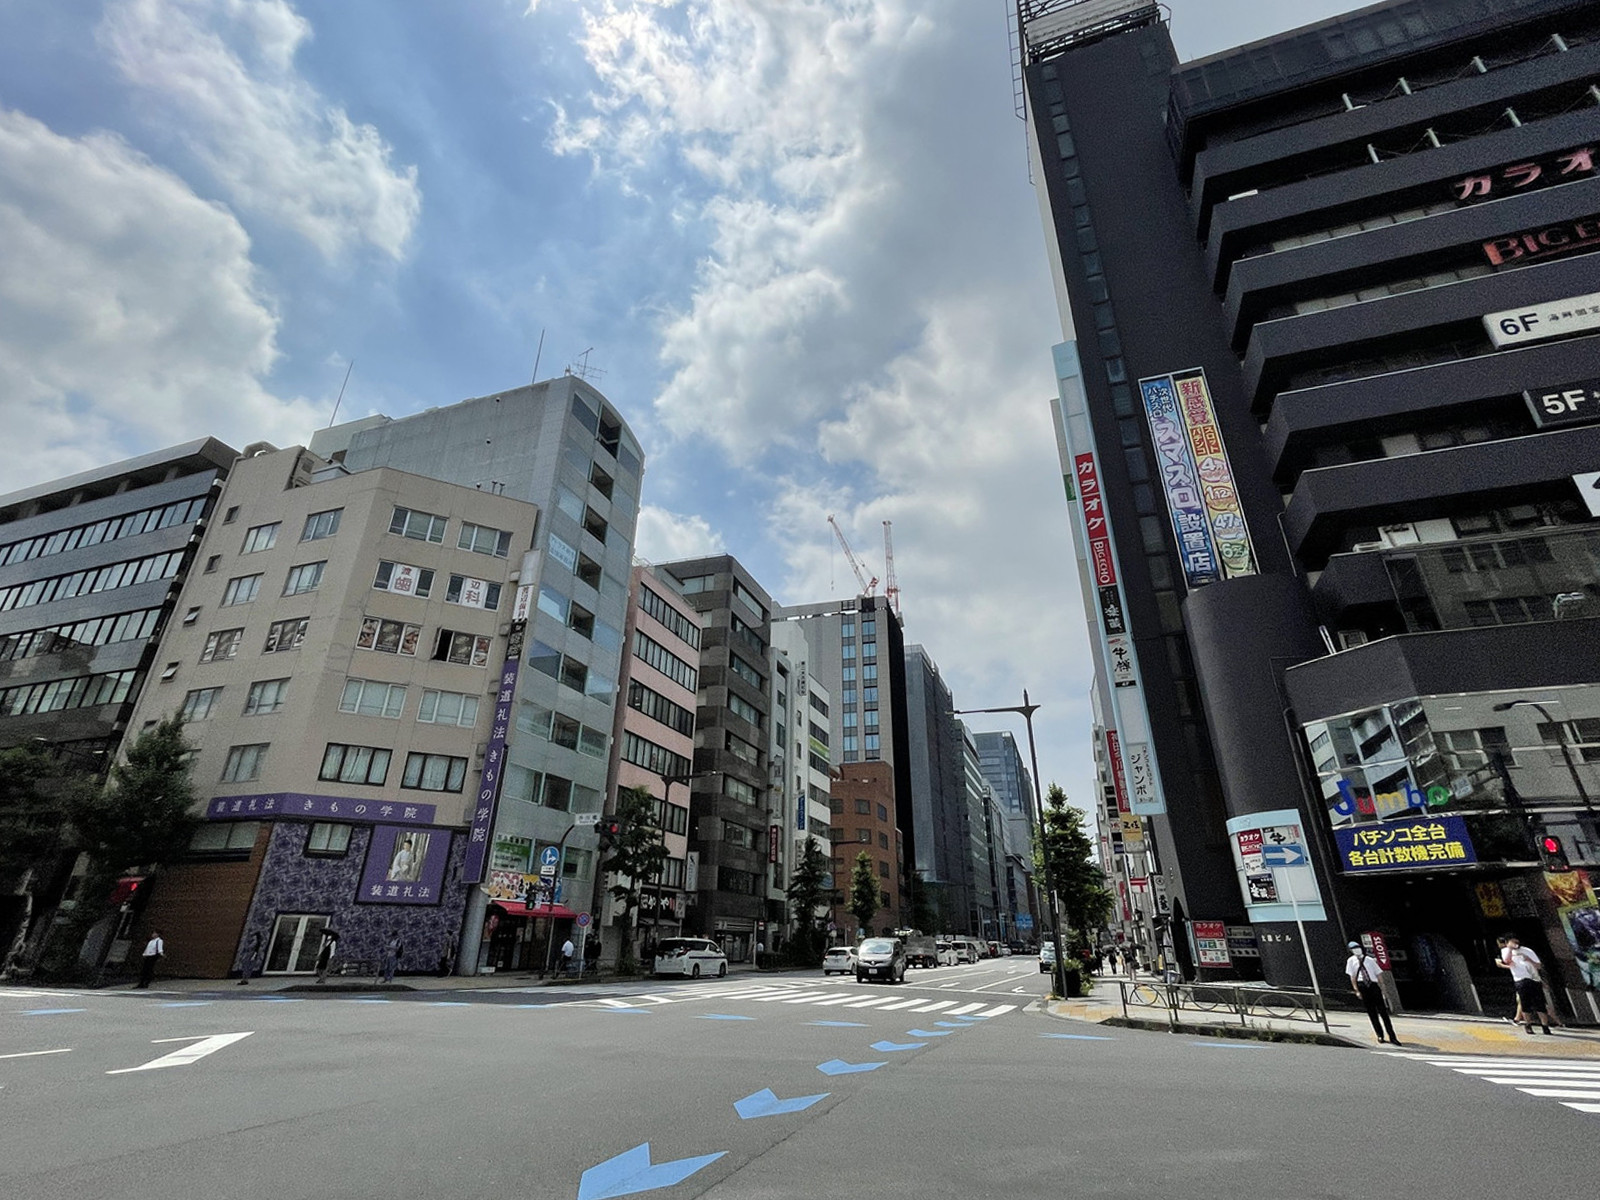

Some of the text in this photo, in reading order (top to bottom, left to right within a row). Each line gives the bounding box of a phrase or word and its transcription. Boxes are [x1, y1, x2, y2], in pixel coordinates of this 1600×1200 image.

[1455, 148, 1595, 200] カラオ
[1499, 312, 1539, 336] 6F
[1180, 380, 1214, 426] 新感覚
[1542, 389, 1586, 414] 5F
[1078, 461, 1105, 531] カラオケ
[1131, 753, 1148, 796] ジャンボ
[303, 799, 418, 819] きもの学院
[1334, 779, 1449, 816] Jumbo
[1353, 823, 1447, 847] パチンコ全台
[1348, 841, 1466, 867] 各台計数機完備
[371, 884, 430, 898] 装道礼法
